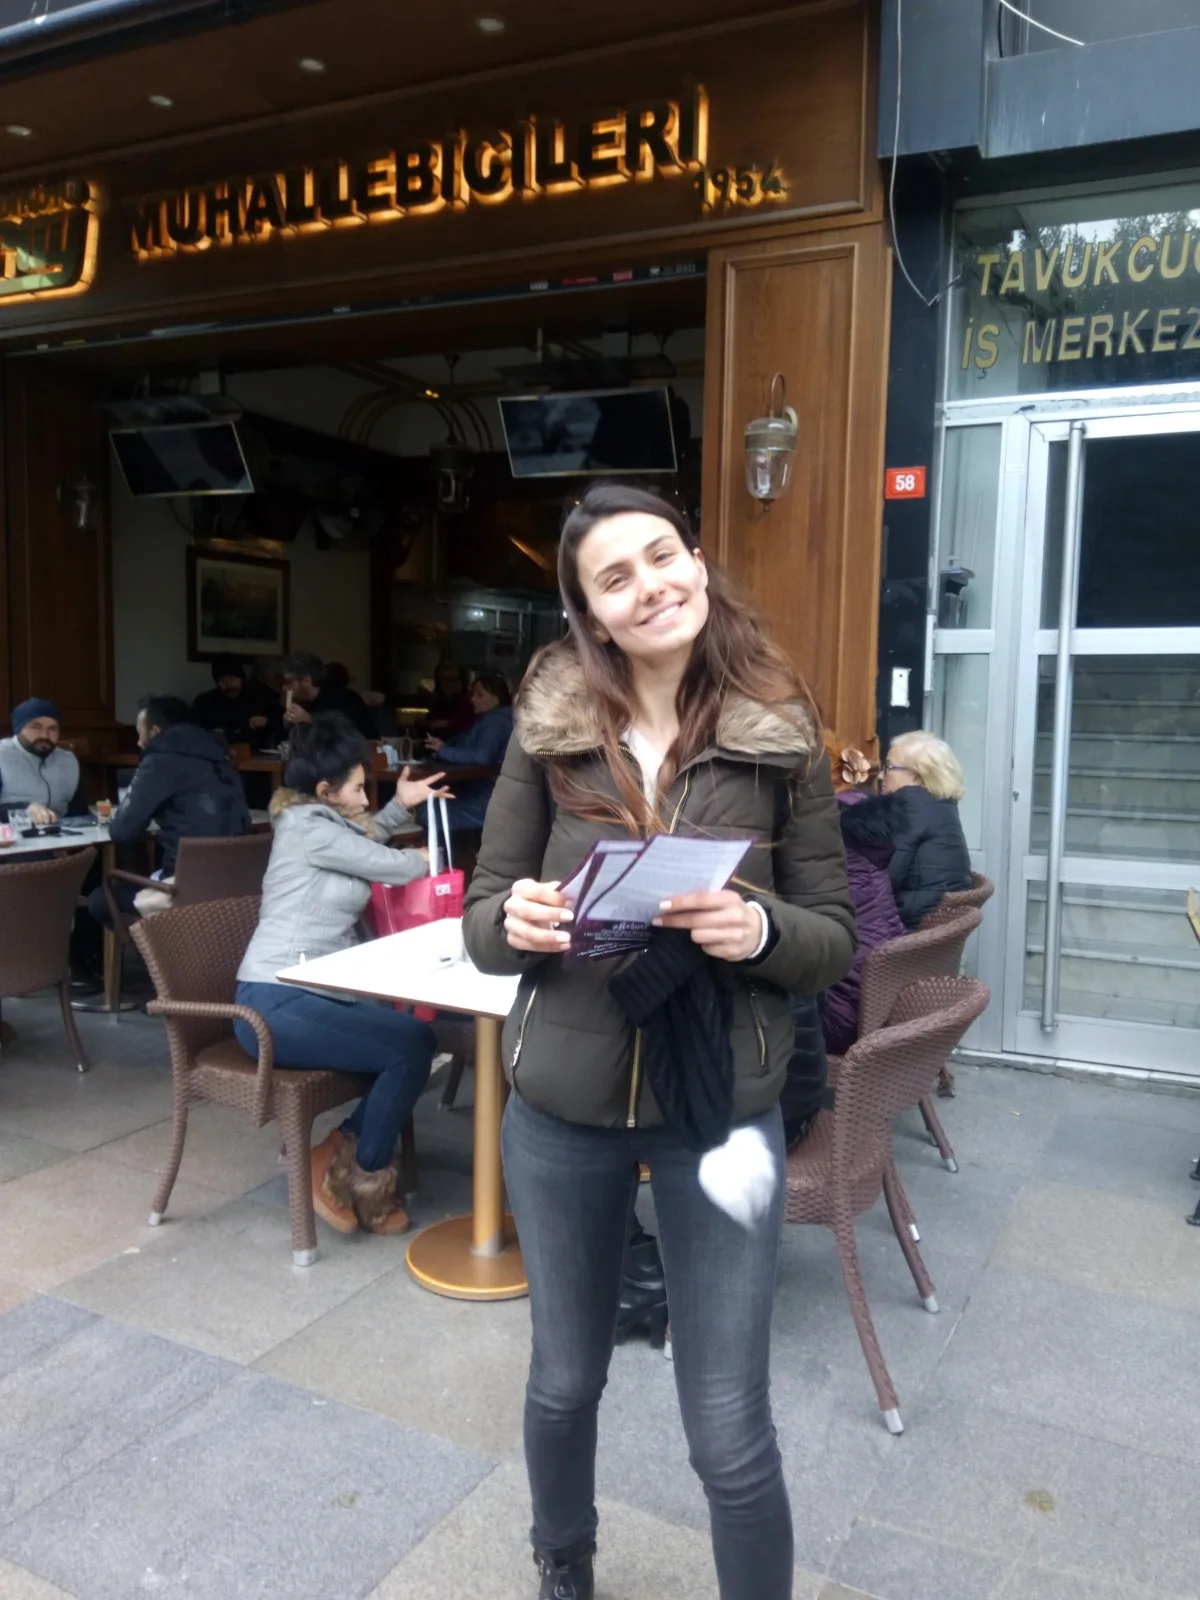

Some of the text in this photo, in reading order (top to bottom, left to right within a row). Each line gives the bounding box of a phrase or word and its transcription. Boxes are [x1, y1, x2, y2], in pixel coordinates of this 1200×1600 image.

[693, 158, 788, 213] 1954
[977, 233, 1200, 297] TAVUKCU
[1022, 306, 1200, 364] MERKEZ
[896, 474, 915, 492] 58
